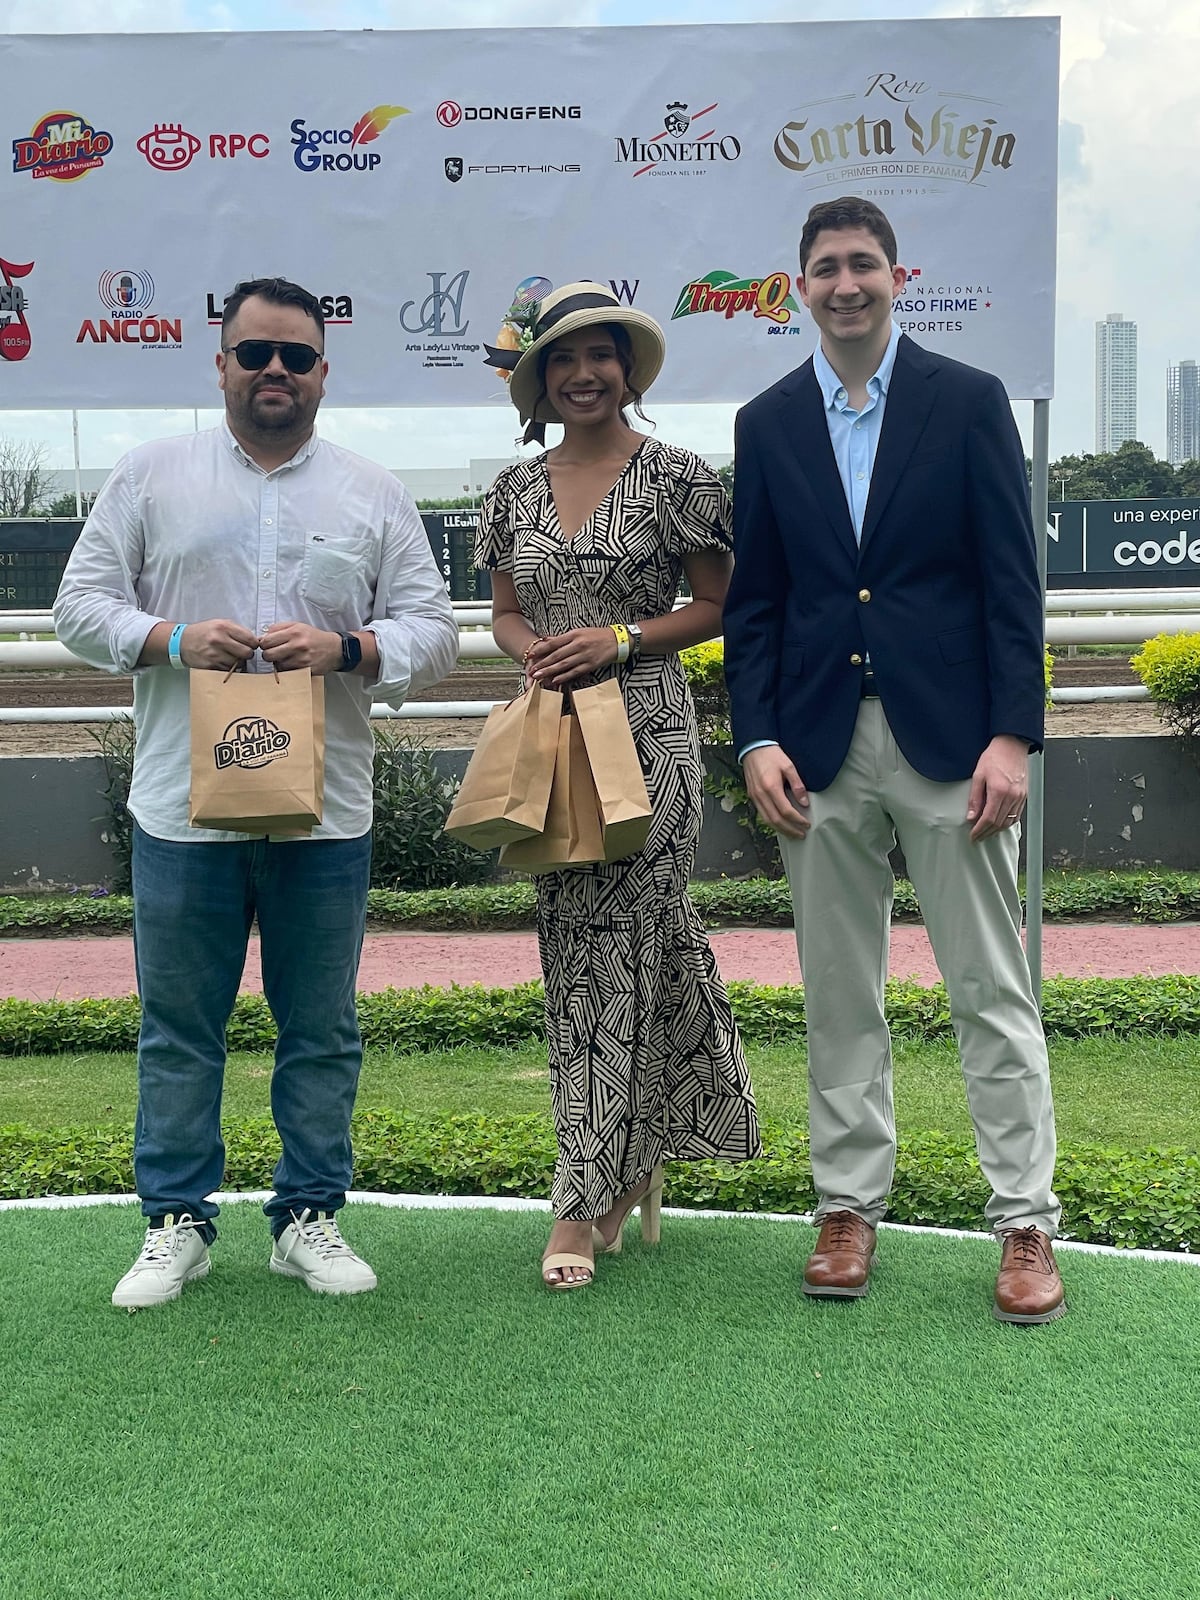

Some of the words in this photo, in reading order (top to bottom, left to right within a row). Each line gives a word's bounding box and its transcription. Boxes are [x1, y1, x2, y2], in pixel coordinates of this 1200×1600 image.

[864, 72, 931, 102] Ron
[465, 106, 581, 120] DONGFENG
[47, 120, 84, 145] Mi
[15, 129, 111, 169] Diario
[209, 134, 270, 159] RPC
[614, 135, 741, 162] MIONETTO
[773, 114, 896, 171] Carta
[904, 104, 1016, 184] Vieja
[294, 142, 381, 172] GROUP
[58, 165, 69, 173] de
[468, 164, 581, 174] FORTHING
[826, 172, 838, 182] EL
[840, 165, 879, 180] PRIMER
[881, 164, 903, 174] RON
[906, 164, 919, 174] DE
[688, 271, 791, 323] TropiQ
[917, 286, 992, 295] NACIONAL
[930, 299, 978, 312] FIRME
[111, 311, 143, 319] RADIO
[76, 313, 182, 343] ANCÓN
[767, 326, 788, 335] 99.7
[1113, 510, 1145, 523] una
[442, 533, 449, 544] 1
[442, 548, 450, 560] 2
[443, 564, 451, 576] 3
[467, 580, 476, 592] 3
[239, 721, 265, 743] Mi
[216, 731, 290, 769] Diario
